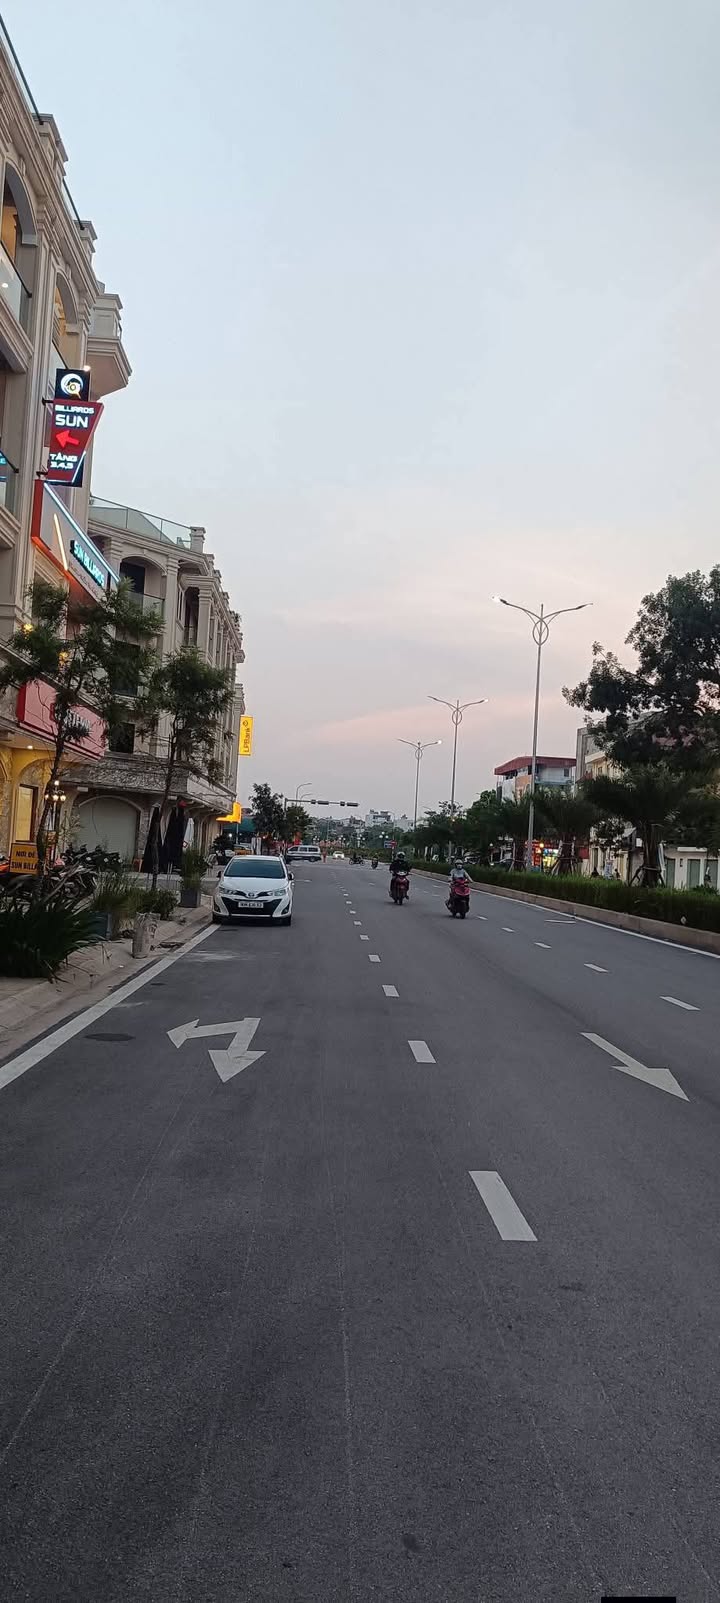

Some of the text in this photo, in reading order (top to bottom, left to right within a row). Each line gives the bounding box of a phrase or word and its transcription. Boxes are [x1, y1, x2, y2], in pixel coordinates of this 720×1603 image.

[55, 405, 94, 414] BILLIARDS
[55, 414, 88, 428] SUN
[74, 540, 84, 562] SUN
[84, 552, 104, 587] BILLIARDS
